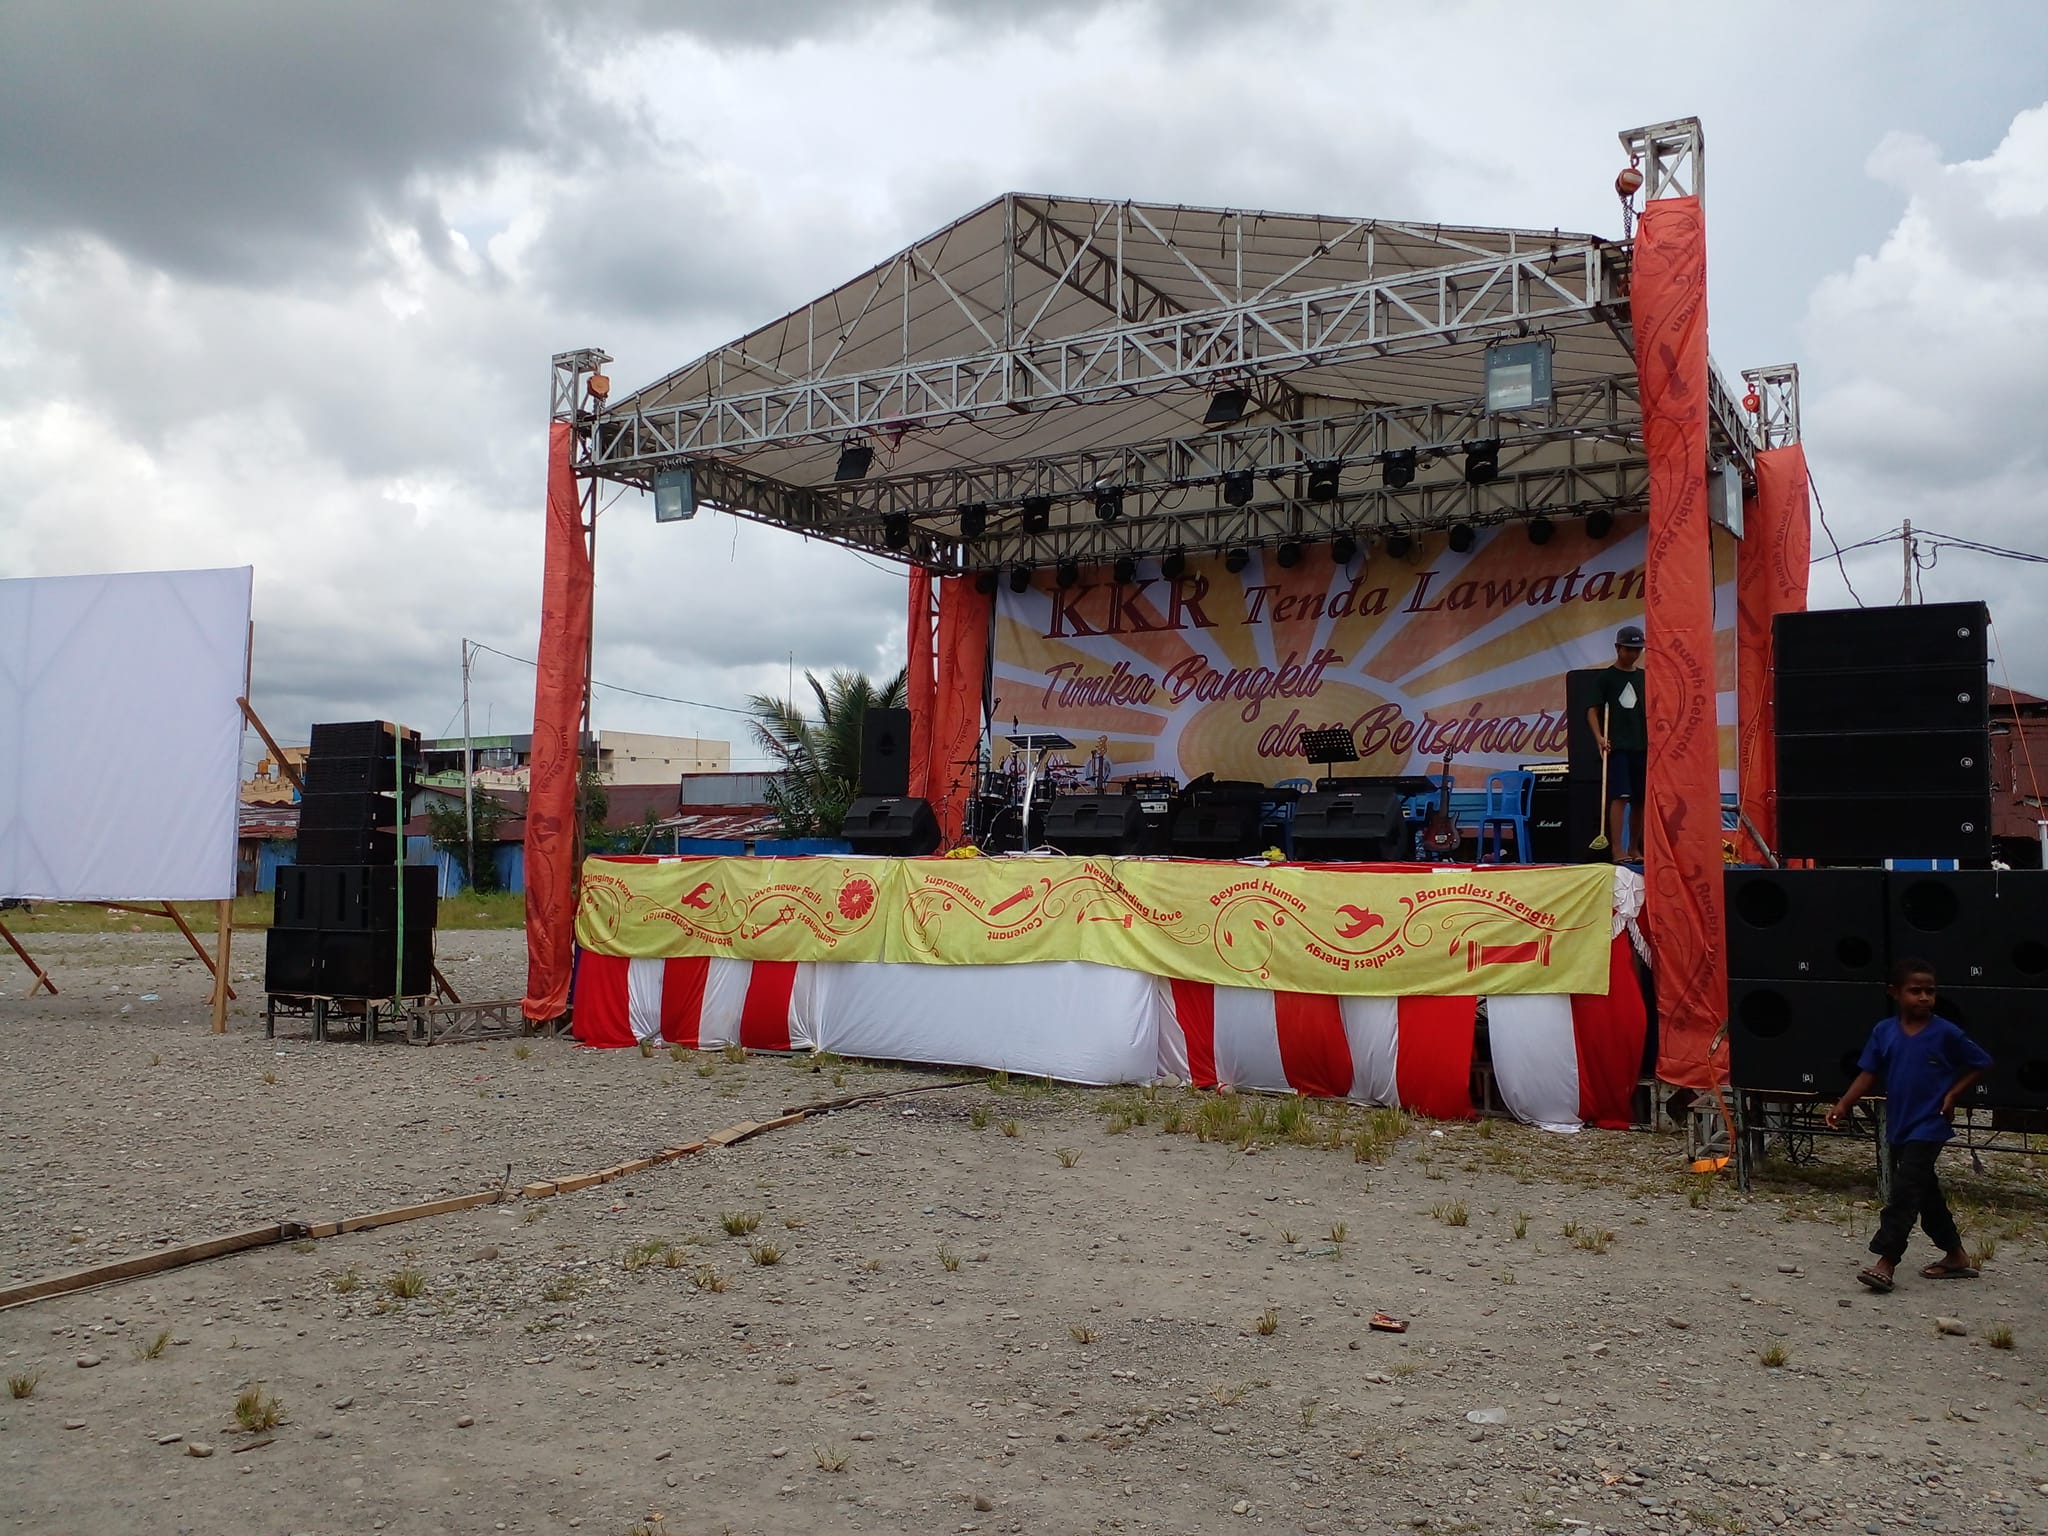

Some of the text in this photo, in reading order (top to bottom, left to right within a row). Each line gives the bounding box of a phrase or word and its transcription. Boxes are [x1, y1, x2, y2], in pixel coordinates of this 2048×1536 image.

[1042, 566, 1646, 640] KKR Tenda Lawatan
[1041, 648, 1344, 723] Timika Bangkit
[1258, 708, 1343, 757] da
[748, 883, 823, 904] Love never Fails
[924, 874, 986, 910] Supranatural
[1084, 863, 1183, 921] Never Ending Love
[1209, 878, 1308, 913] Beyond Human
[1415, 883, 1556, 926] Boundless Strength
[987, 917, 1043, 941] Covenant
[1305, 942, 1405, 970] Endless Energy
